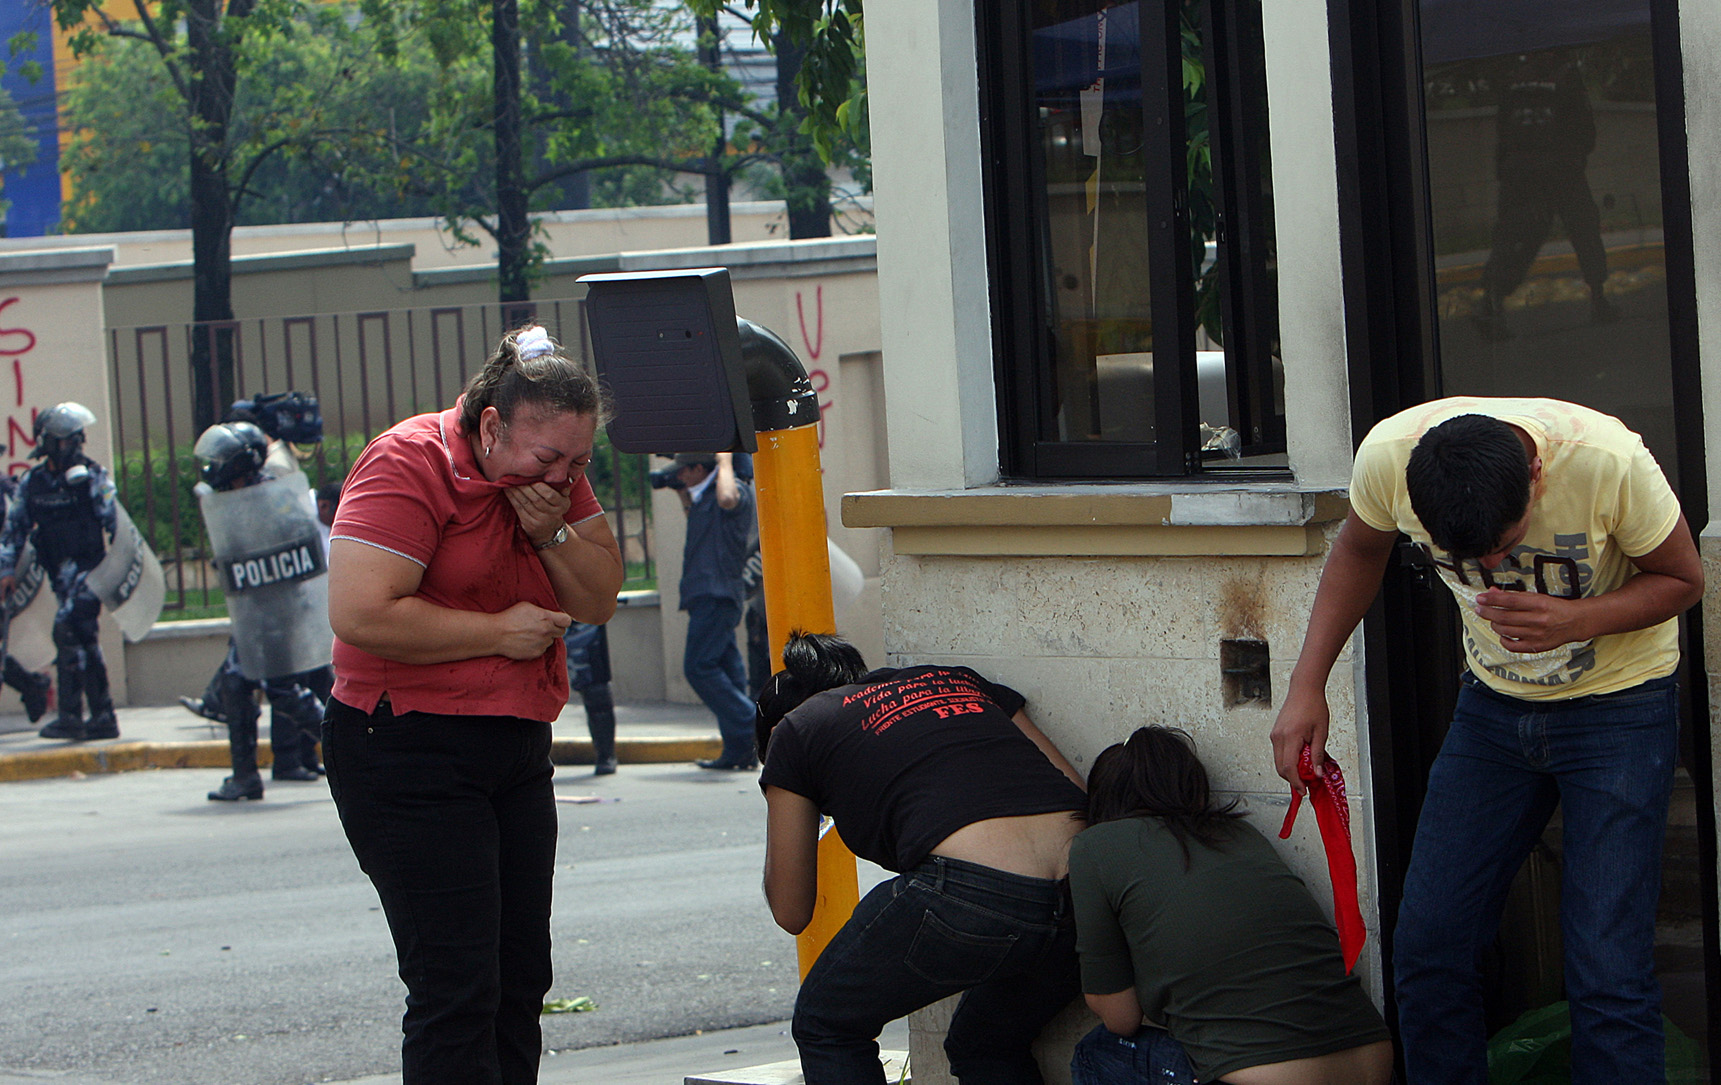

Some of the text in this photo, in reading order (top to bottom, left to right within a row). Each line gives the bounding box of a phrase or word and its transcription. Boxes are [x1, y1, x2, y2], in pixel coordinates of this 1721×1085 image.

[231, 546, 315, 590] POLICIA
[861, 699, 898, 731] Lucha
[902, 687, 933, 705] para
[938, 686, 952, 694] la
[862, 690, 893, 709] Vida
[897, 681, 929, 694] para
[932, 702, 984, 719] FES
[874, 714, 903, 736] FRENTE
